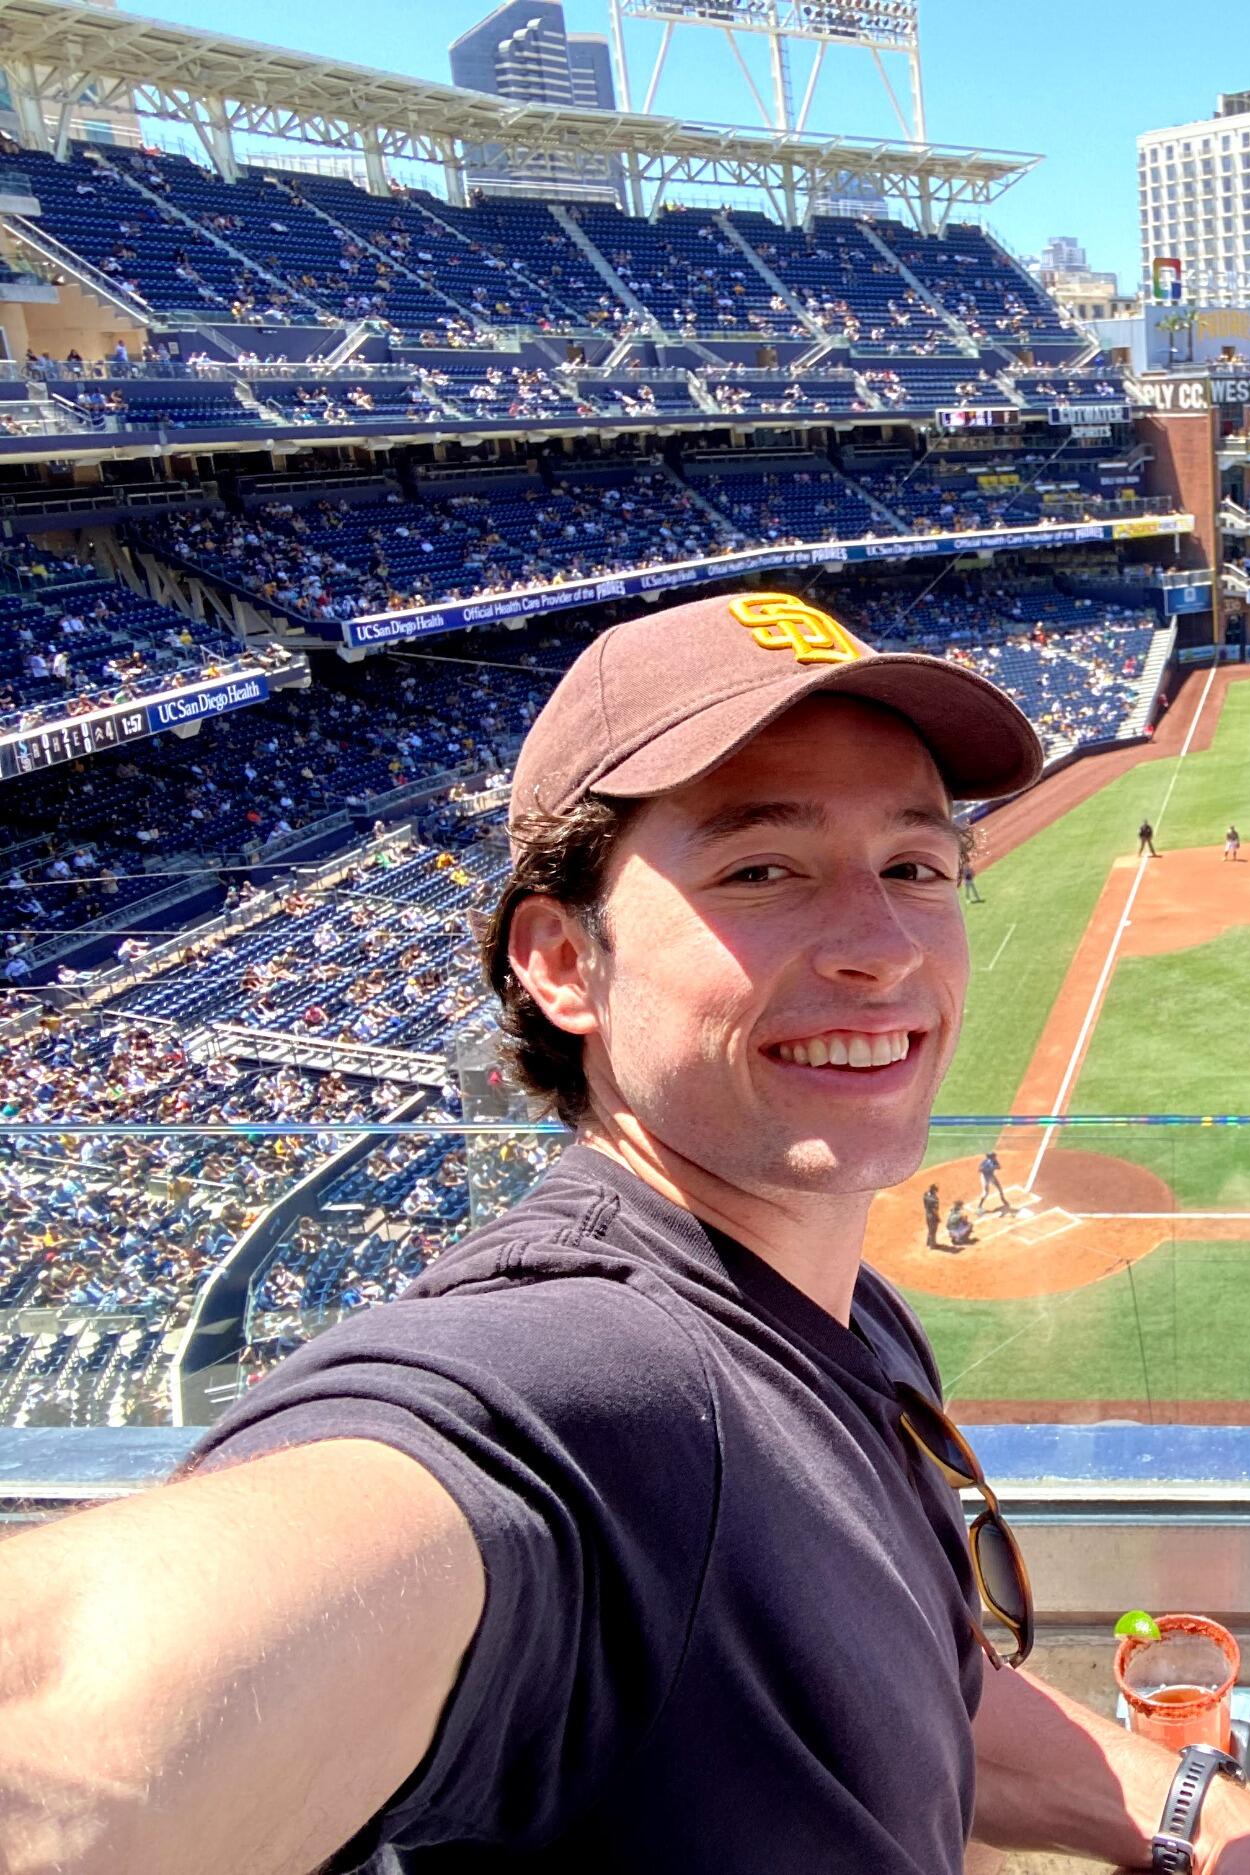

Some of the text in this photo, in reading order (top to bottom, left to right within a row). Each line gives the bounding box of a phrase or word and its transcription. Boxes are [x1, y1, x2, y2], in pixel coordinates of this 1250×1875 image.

[812, 547, 848, 563] PADRES
[463, 604, 493, 621] Official
[495, 600, 521, 615] Health
[521, 596, 540, 610] Care
[541, 591, 572, 608] Provider
[574, 589, 581, 601] of
[582, 587, 595, 599] the
[357, 614, 444, 641] UC San Diego Health
[158, 681, 260, 723] UC San Diego Health
[105, 721, 114, 740] 4
[121, 714, 142, 735] 1:57
